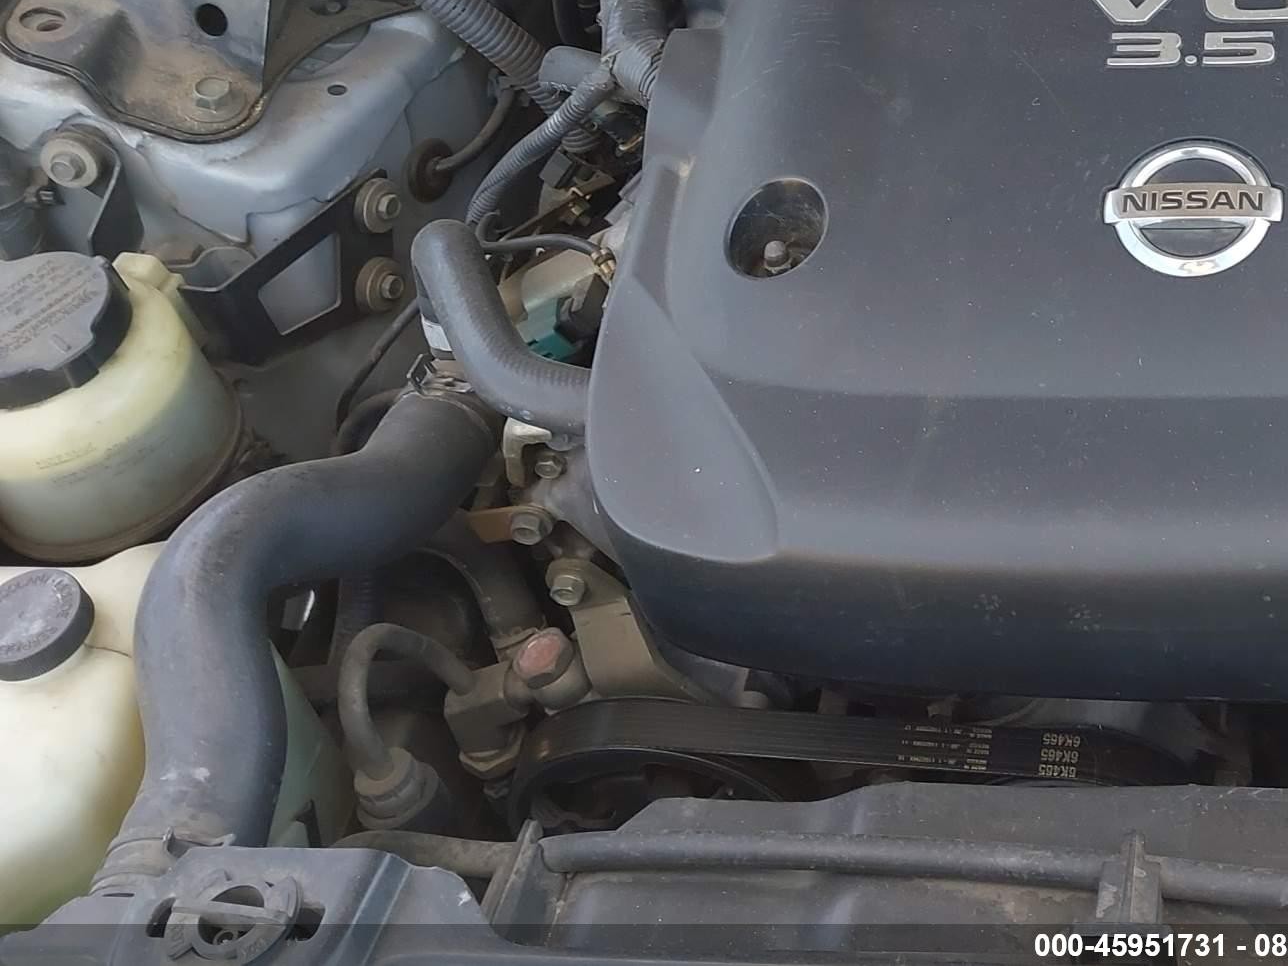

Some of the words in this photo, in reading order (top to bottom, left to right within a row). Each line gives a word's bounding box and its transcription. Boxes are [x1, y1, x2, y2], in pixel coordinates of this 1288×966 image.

[1106, 30, 1277, 67] 3.5
[1121, 189, 1265, 212] NISSAN
[1042, 731, 1082, 748] 6K465
[1040, 747, 1080, 764] 6K465
[1038, 763, 1078, 778] 6K465
